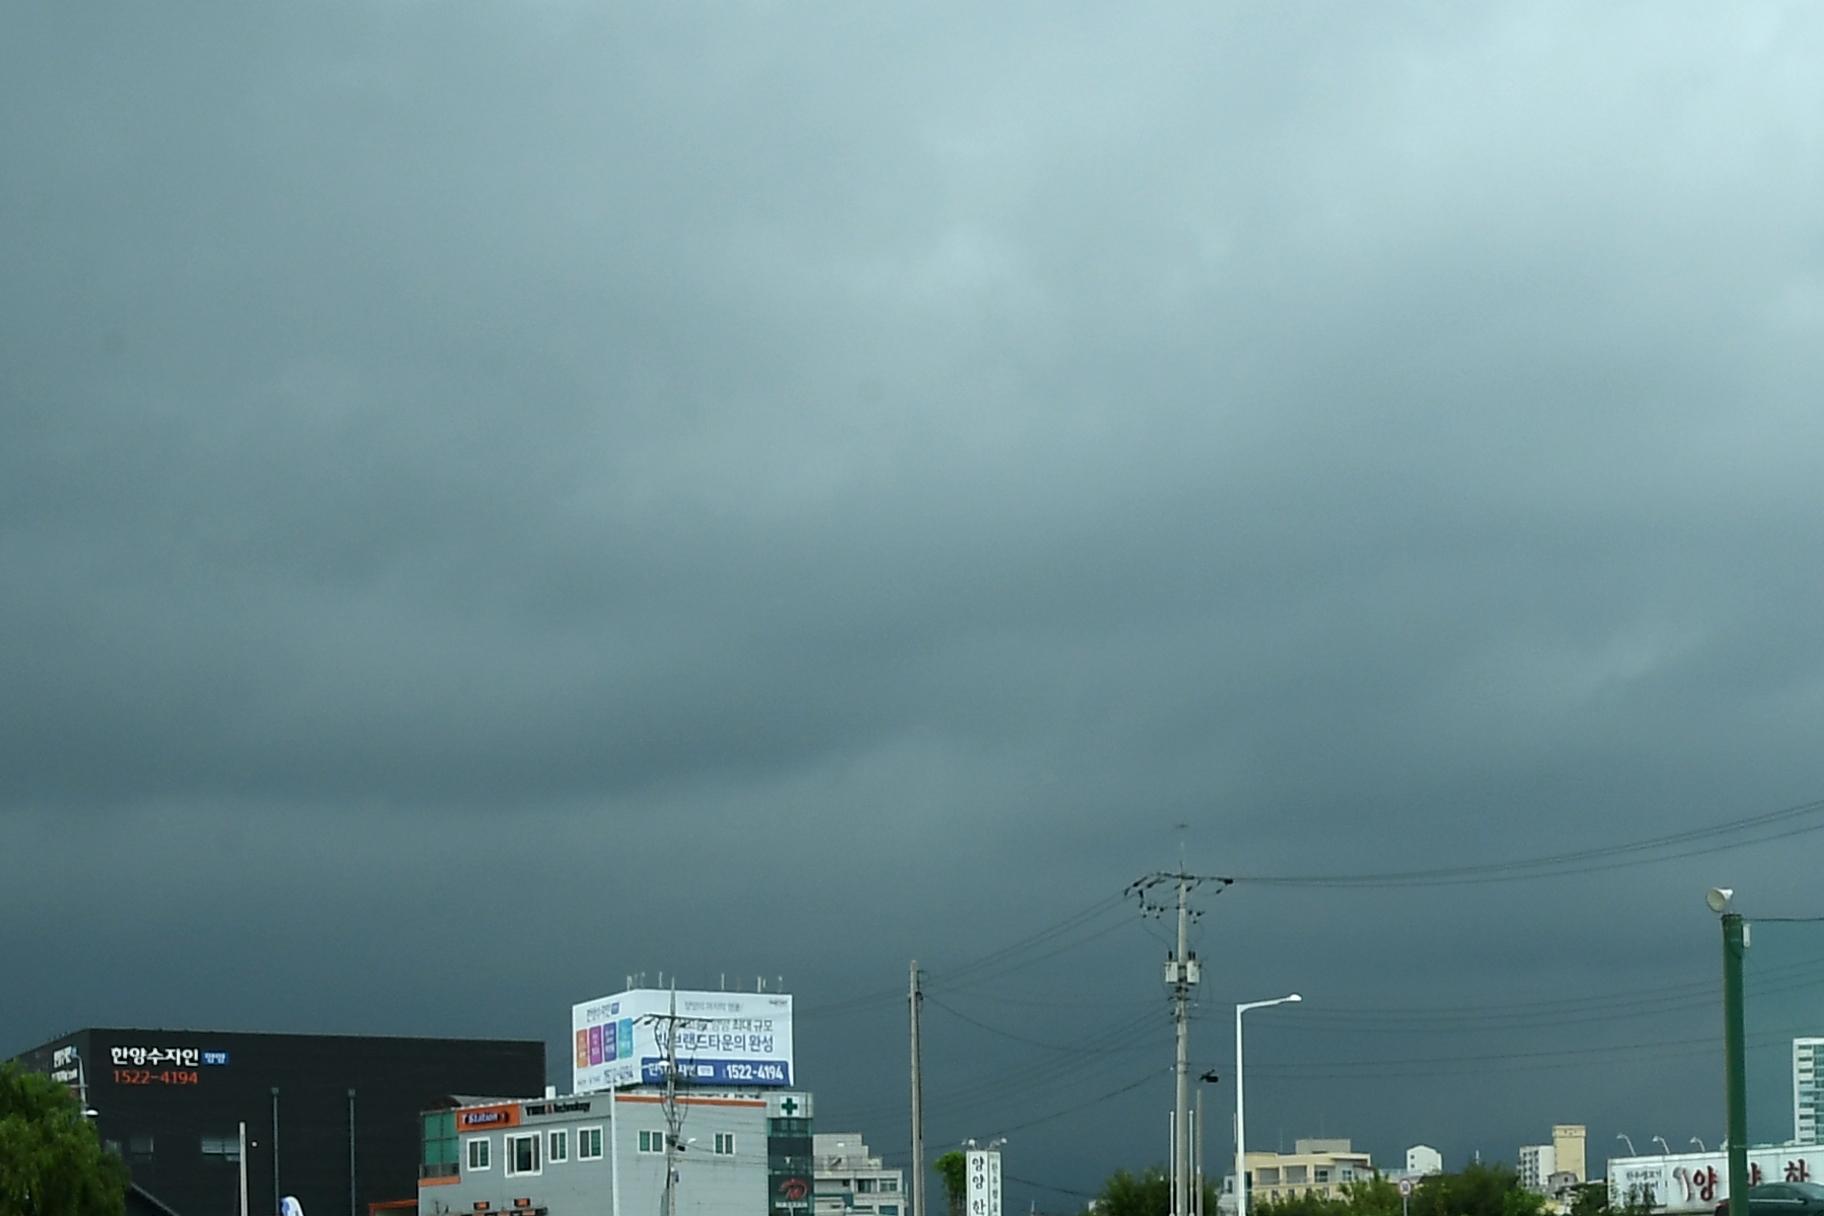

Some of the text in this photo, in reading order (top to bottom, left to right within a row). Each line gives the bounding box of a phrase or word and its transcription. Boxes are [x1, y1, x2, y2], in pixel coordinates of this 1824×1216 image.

[753, 1019, 774, 1033] 규모
[748, 1033, 774, 1054] 완성
[111, 1047, 199, 1067] 한양수자인
[113, 1070, 198, 1085] 1522-4194
[726, 1064, 784, 1080] 1522-4194
[971, 1156, 985, 1190] 양양
